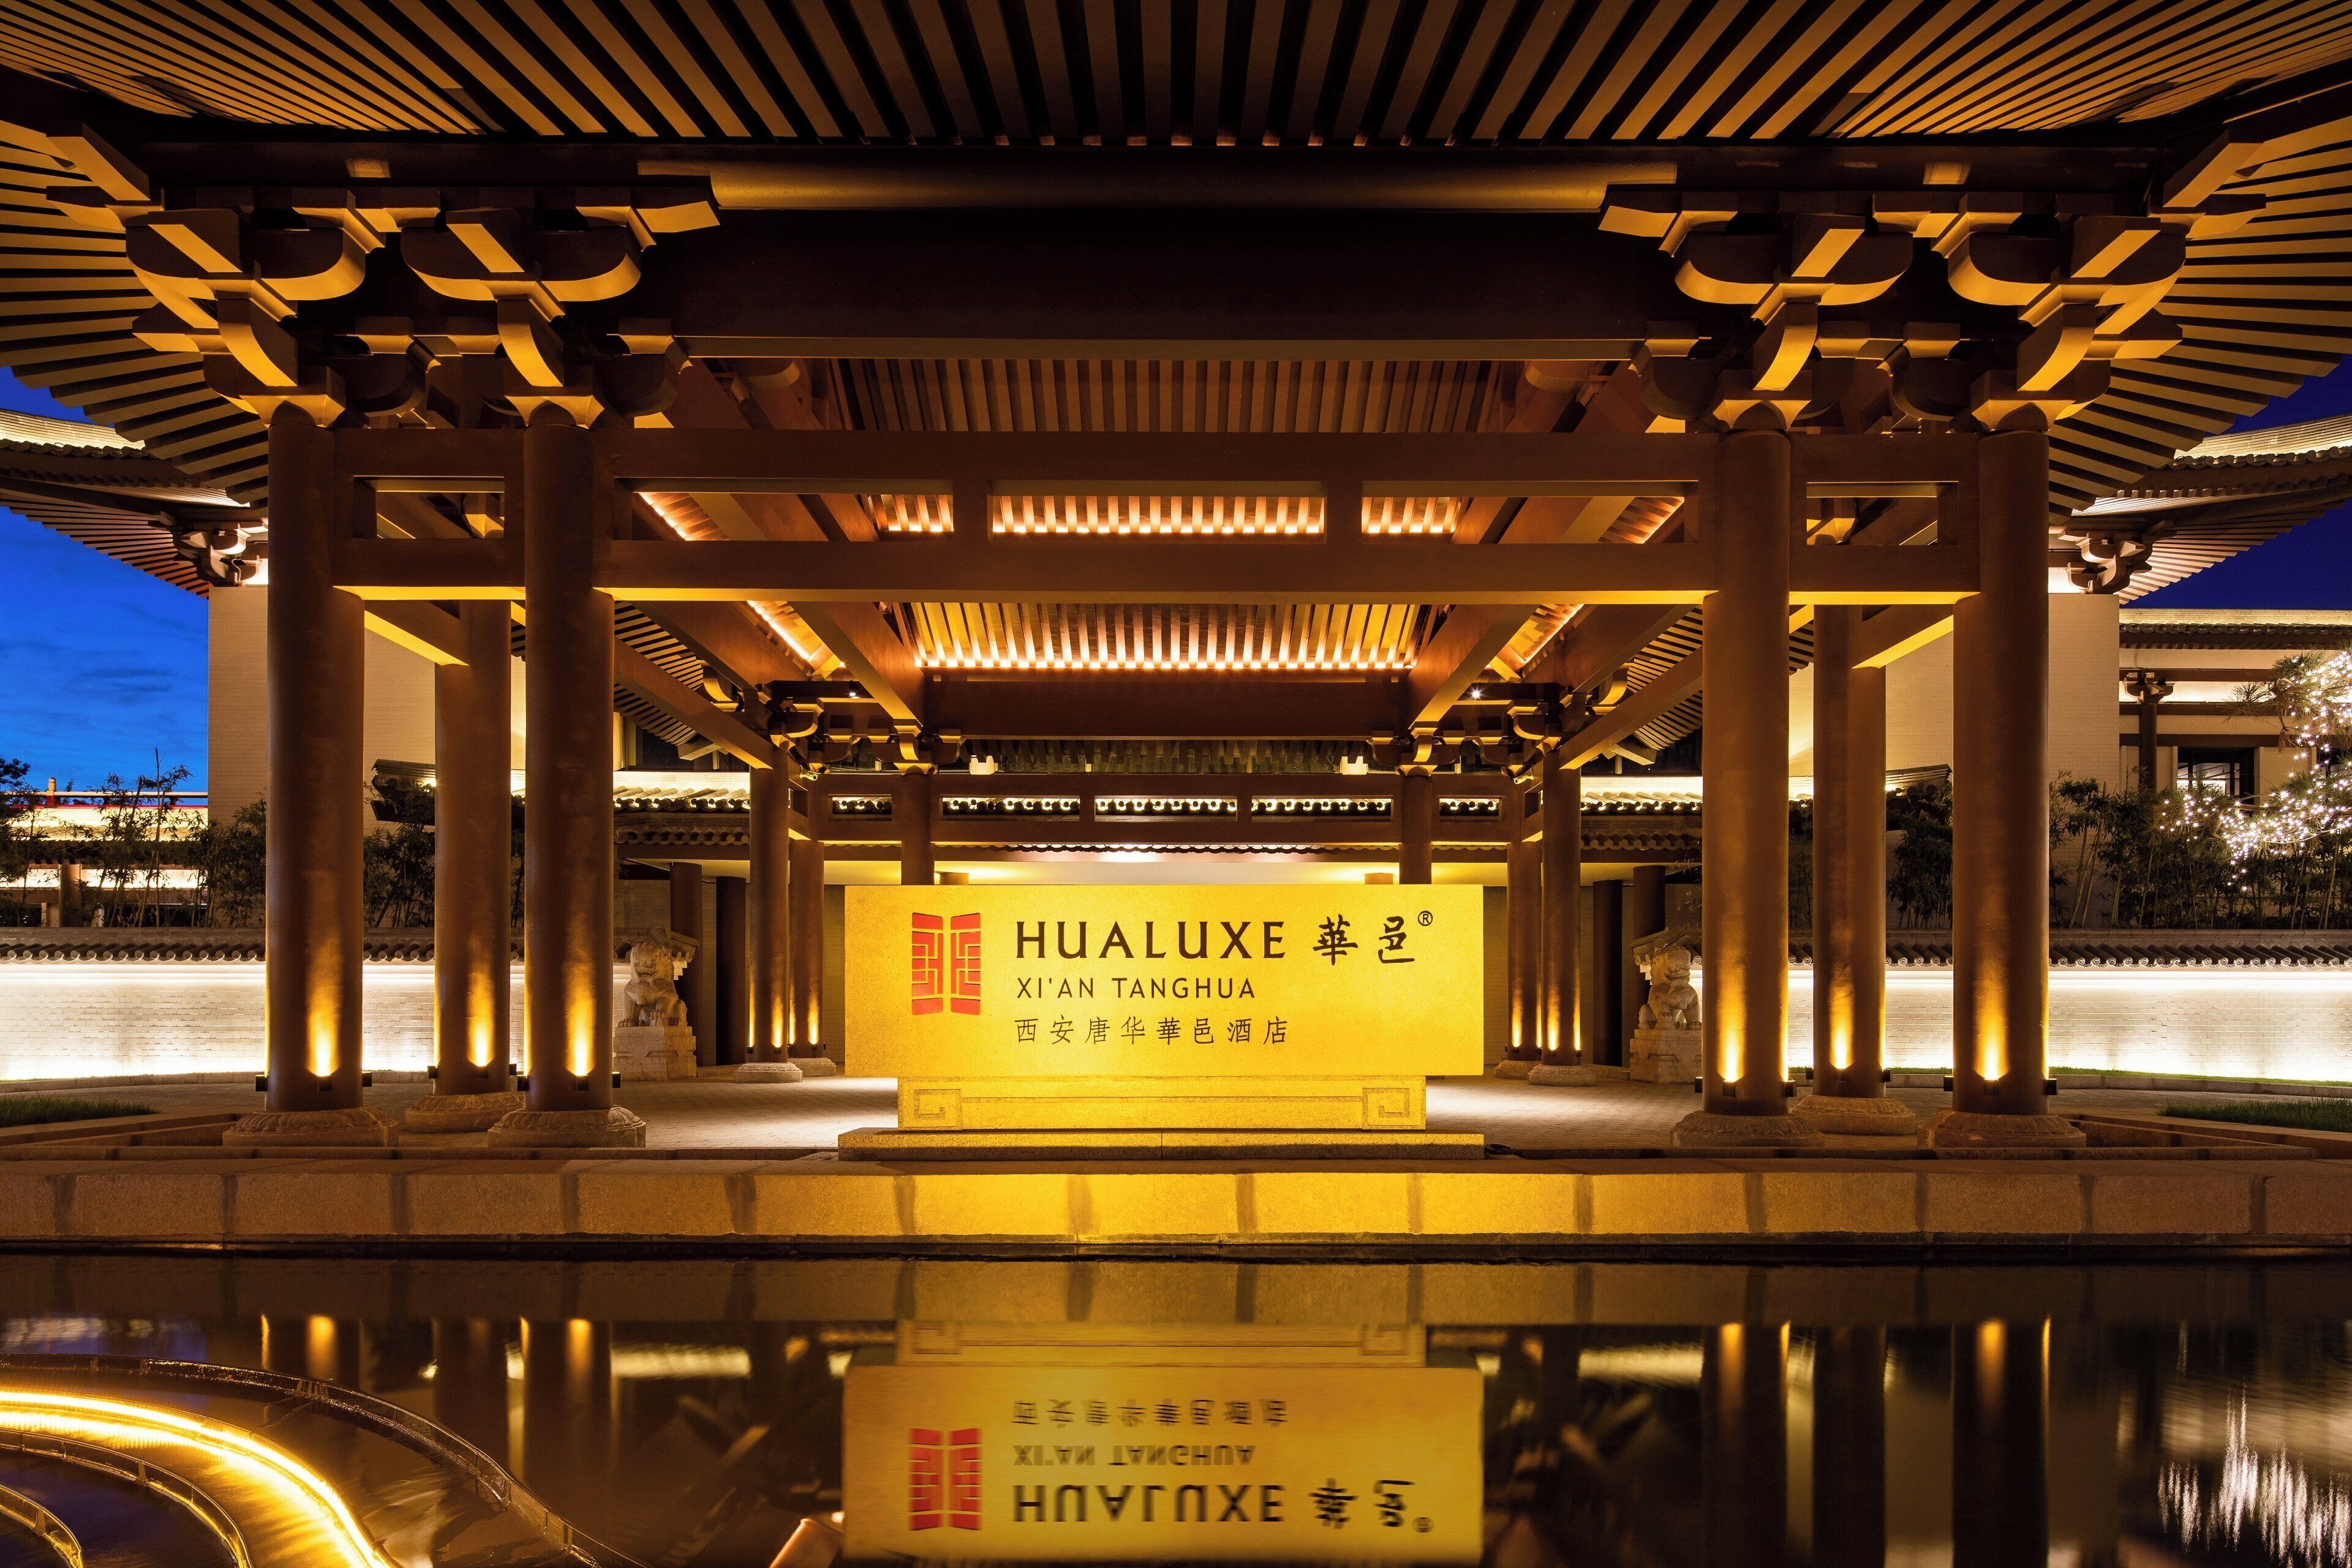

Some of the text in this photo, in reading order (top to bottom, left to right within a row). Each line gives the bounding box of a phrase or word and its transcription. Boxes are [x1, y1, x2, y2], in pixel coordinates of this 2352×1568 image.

[1016, 921, 1286, 959] HUALUXE
[1017, 977, 1256, 999] XI'AN TANGHUA
[1014, 1014, 1288, 1046] 西安唐华華邑酒店
